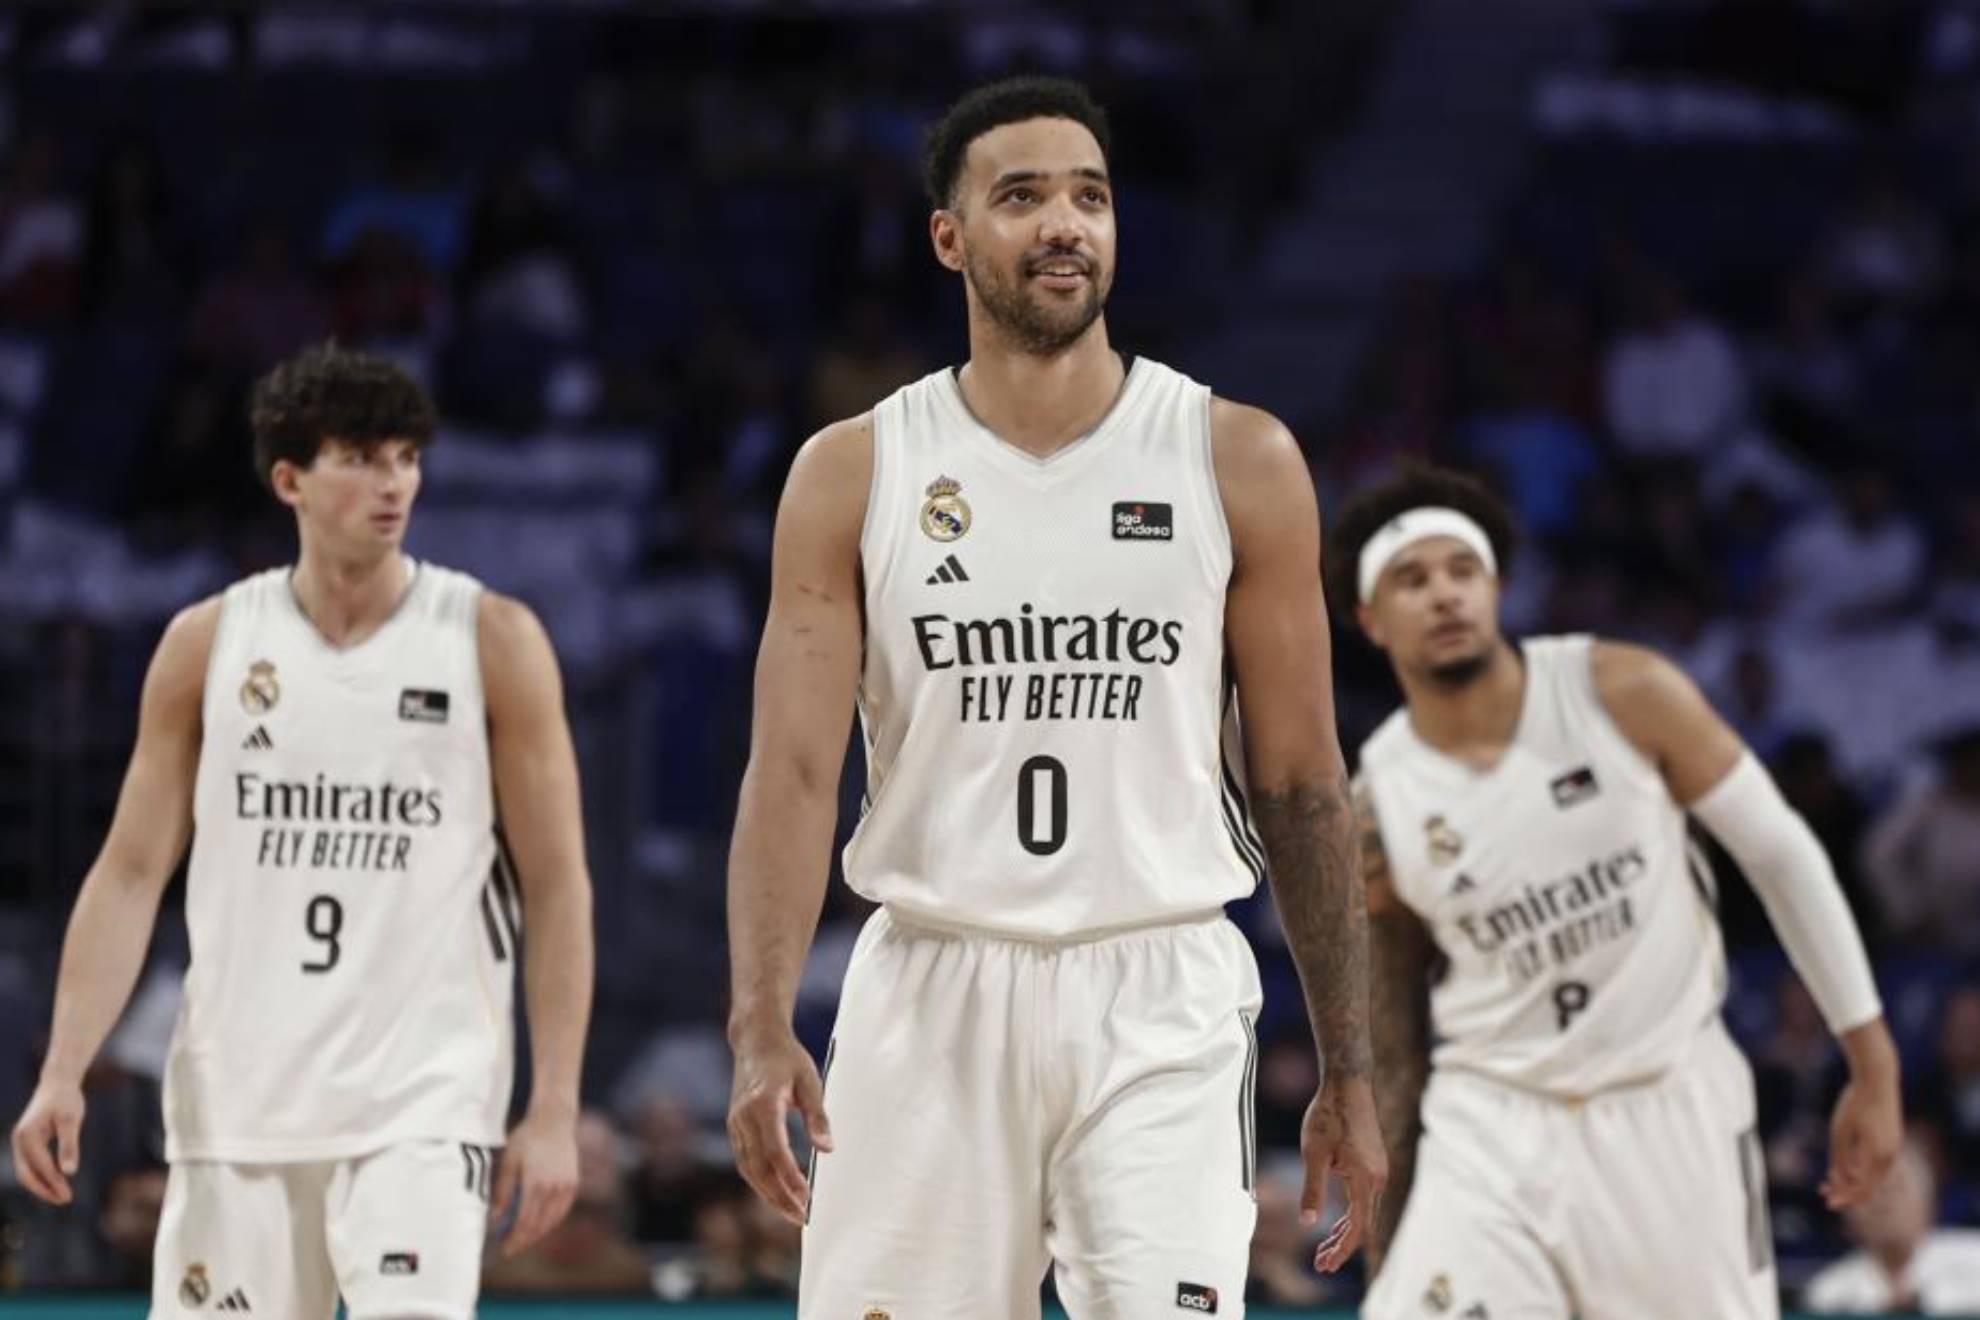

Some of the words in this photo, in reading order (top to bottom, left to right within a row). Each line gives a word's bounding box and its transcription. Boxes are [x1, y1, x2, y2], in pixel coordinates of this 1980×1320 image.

[911, 602, 1183, 672] Emirates
[960, 675, 1013, 723] FLY
[1024, 672, 1143, 722] BETTER
[235, 771, 443, 828] Emirates
[1016, 754, 1068, 857] 0
[257, 827, 306, 868] FLY
[311, 830, 412, 872] BETTER
[301, 893, 344, 975] 9
